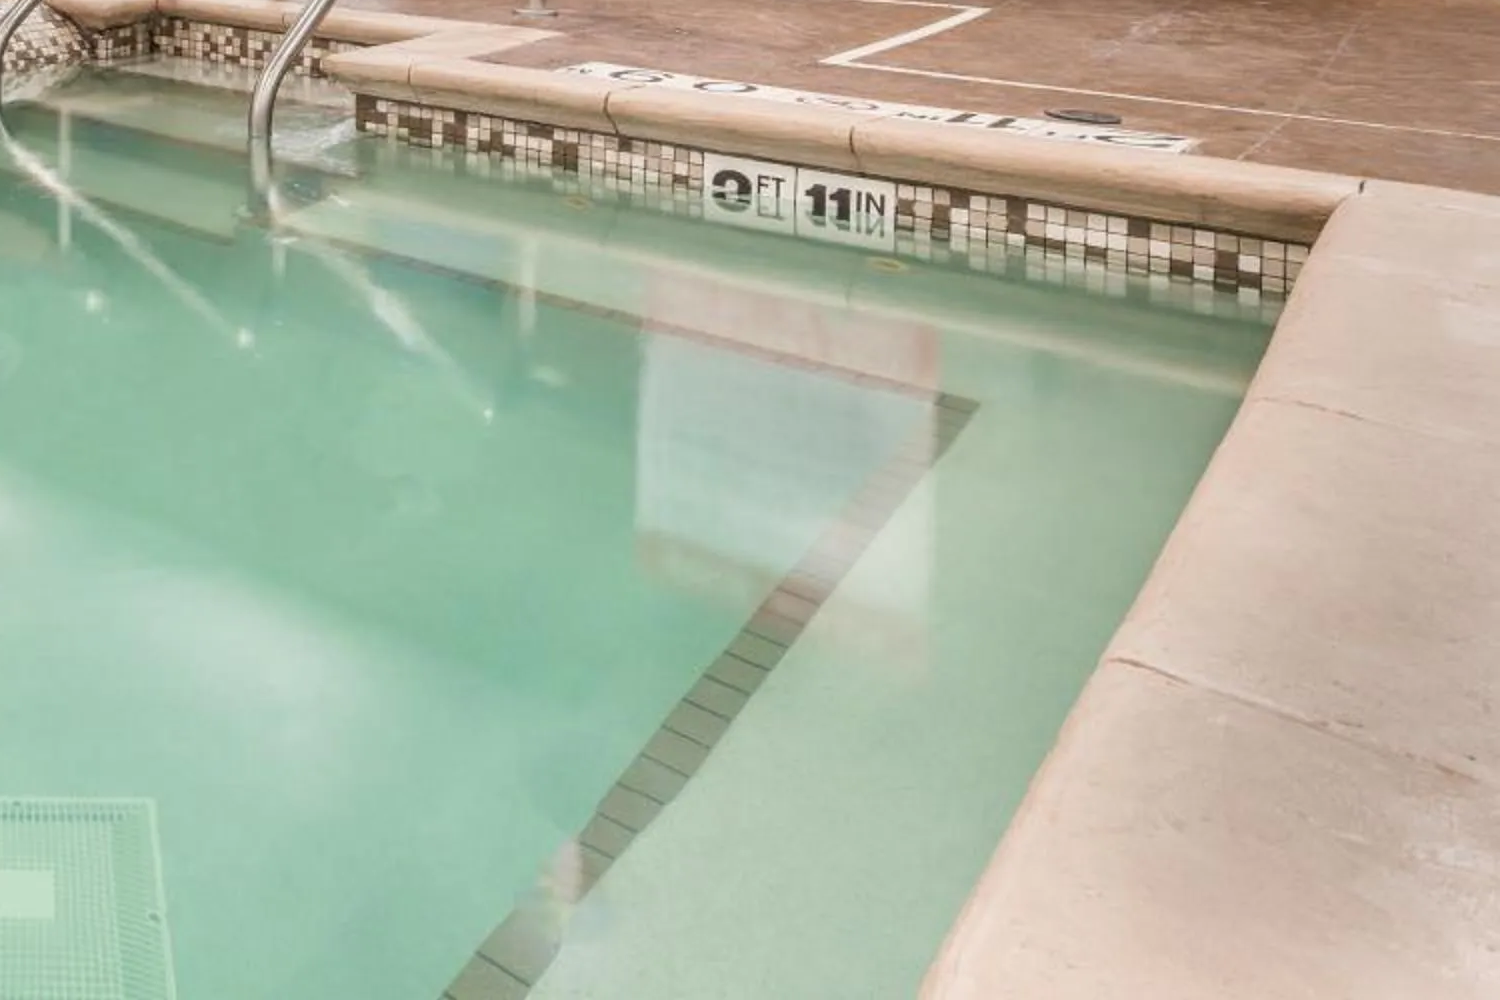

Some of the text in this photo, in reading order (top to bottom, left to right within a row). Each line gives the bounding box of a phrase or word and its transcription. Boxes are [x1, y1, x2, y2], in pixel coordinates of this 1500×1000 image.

[757, 174, 786, 199] FT
[804, 184, 852, 221] 11
[856, 190, 886, 217] IN
